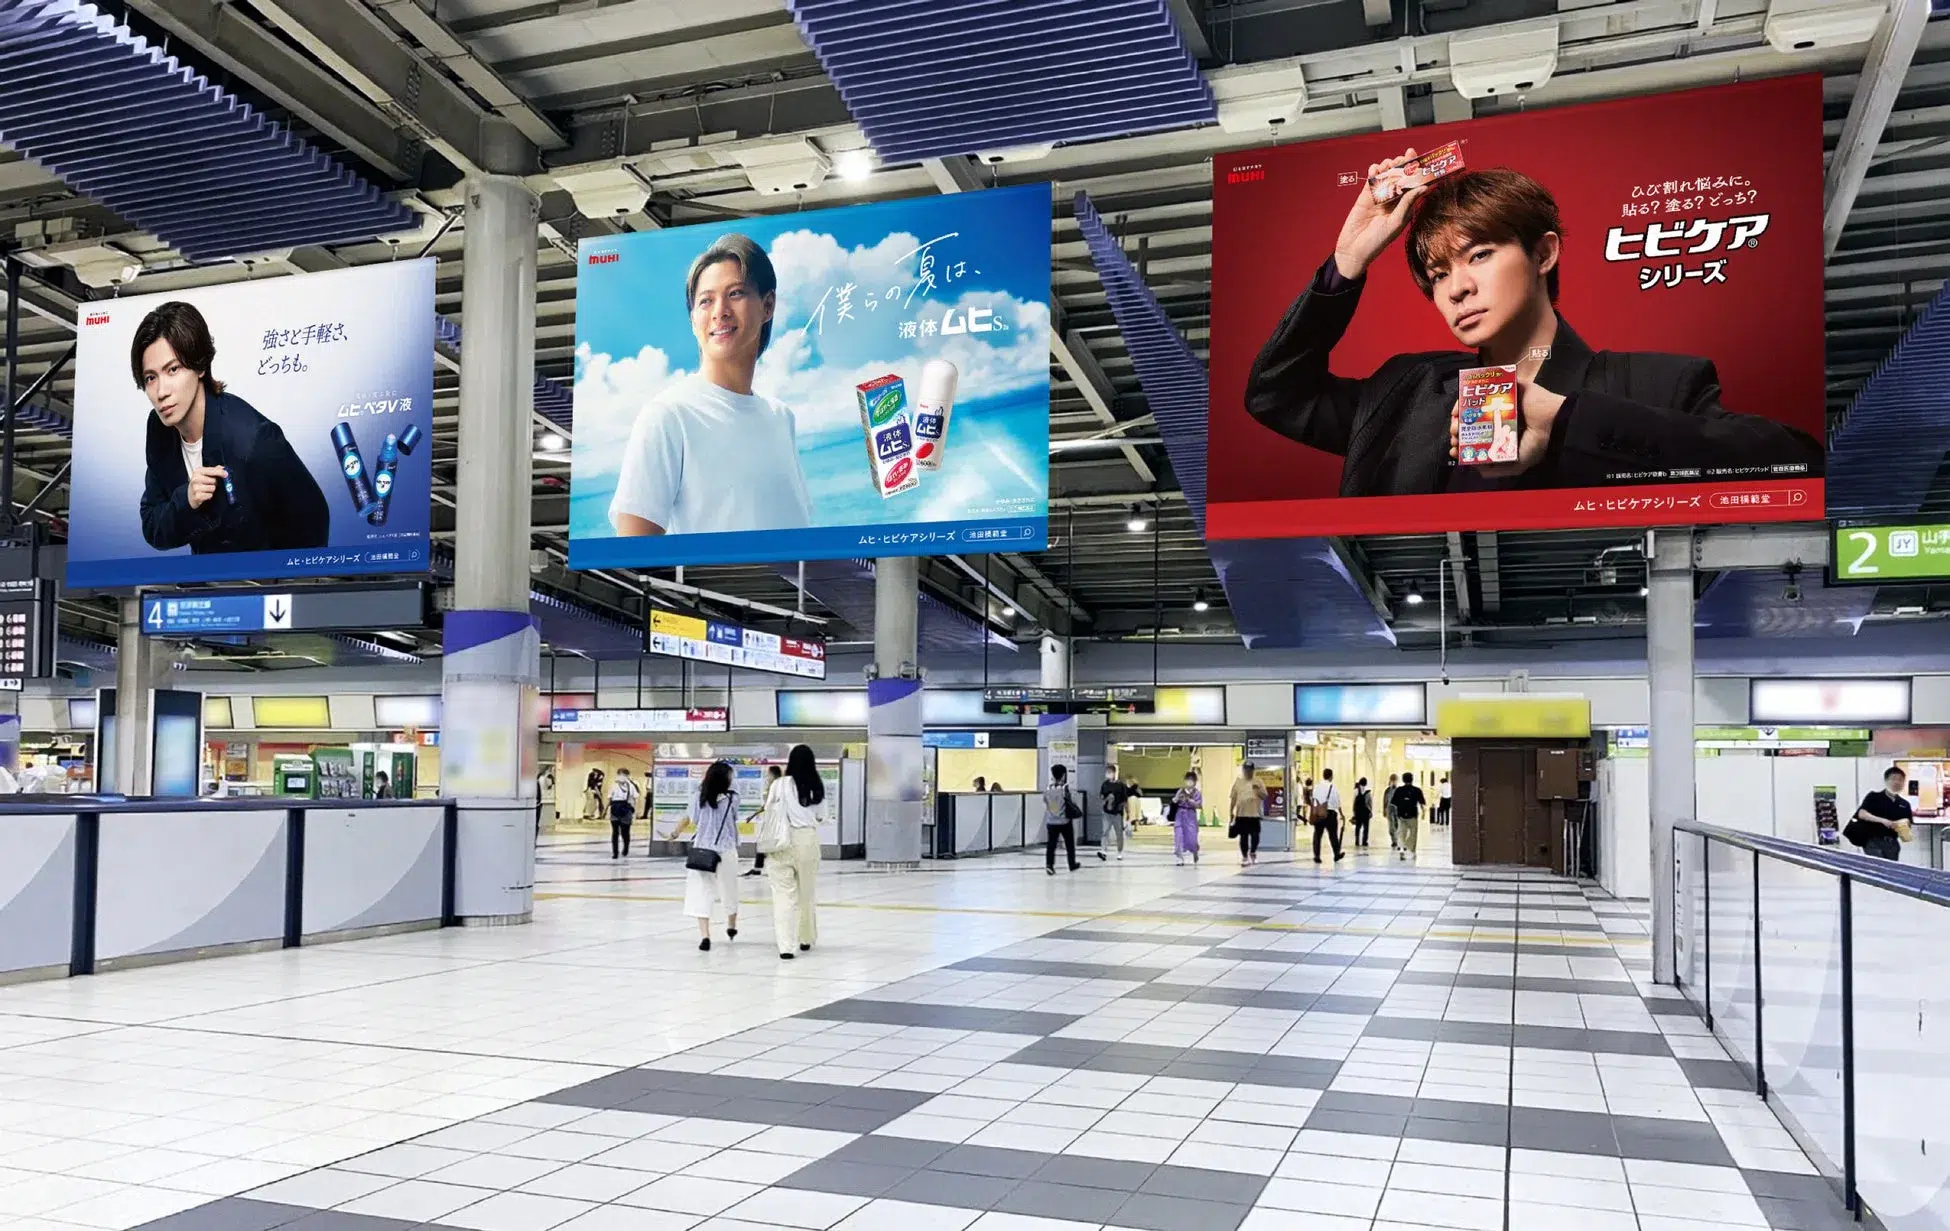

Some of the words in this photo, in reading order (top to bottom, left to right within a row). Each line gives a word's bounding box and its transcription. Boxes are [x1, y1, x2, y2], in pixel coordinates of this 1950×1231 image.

[1631, 175, 1751, 198] ひび割れ悩みに。
[1639, 259, 1728, 290] シリーズ
[262, 322, 348, 350] 強さと手軽さ、
[257, 353, 308, 375] どっちも。
[1531, 348, 1549, 358] 貼る
[1463, 382, 1513, 397] ヒビケア
[1573, 495, 1701, 512] ムヒ・ヒビケアシリーズ
[858, 531, 956, 545] ムヒ・ヒビケアシリーズ
[287, 554, 360, 566] ムヒ・ヒビケアシリーズ
[1848, 531, 1879, 574] 2
[1896, 538, 1911, 549] JY
[147, 601, 164, 629] 4
